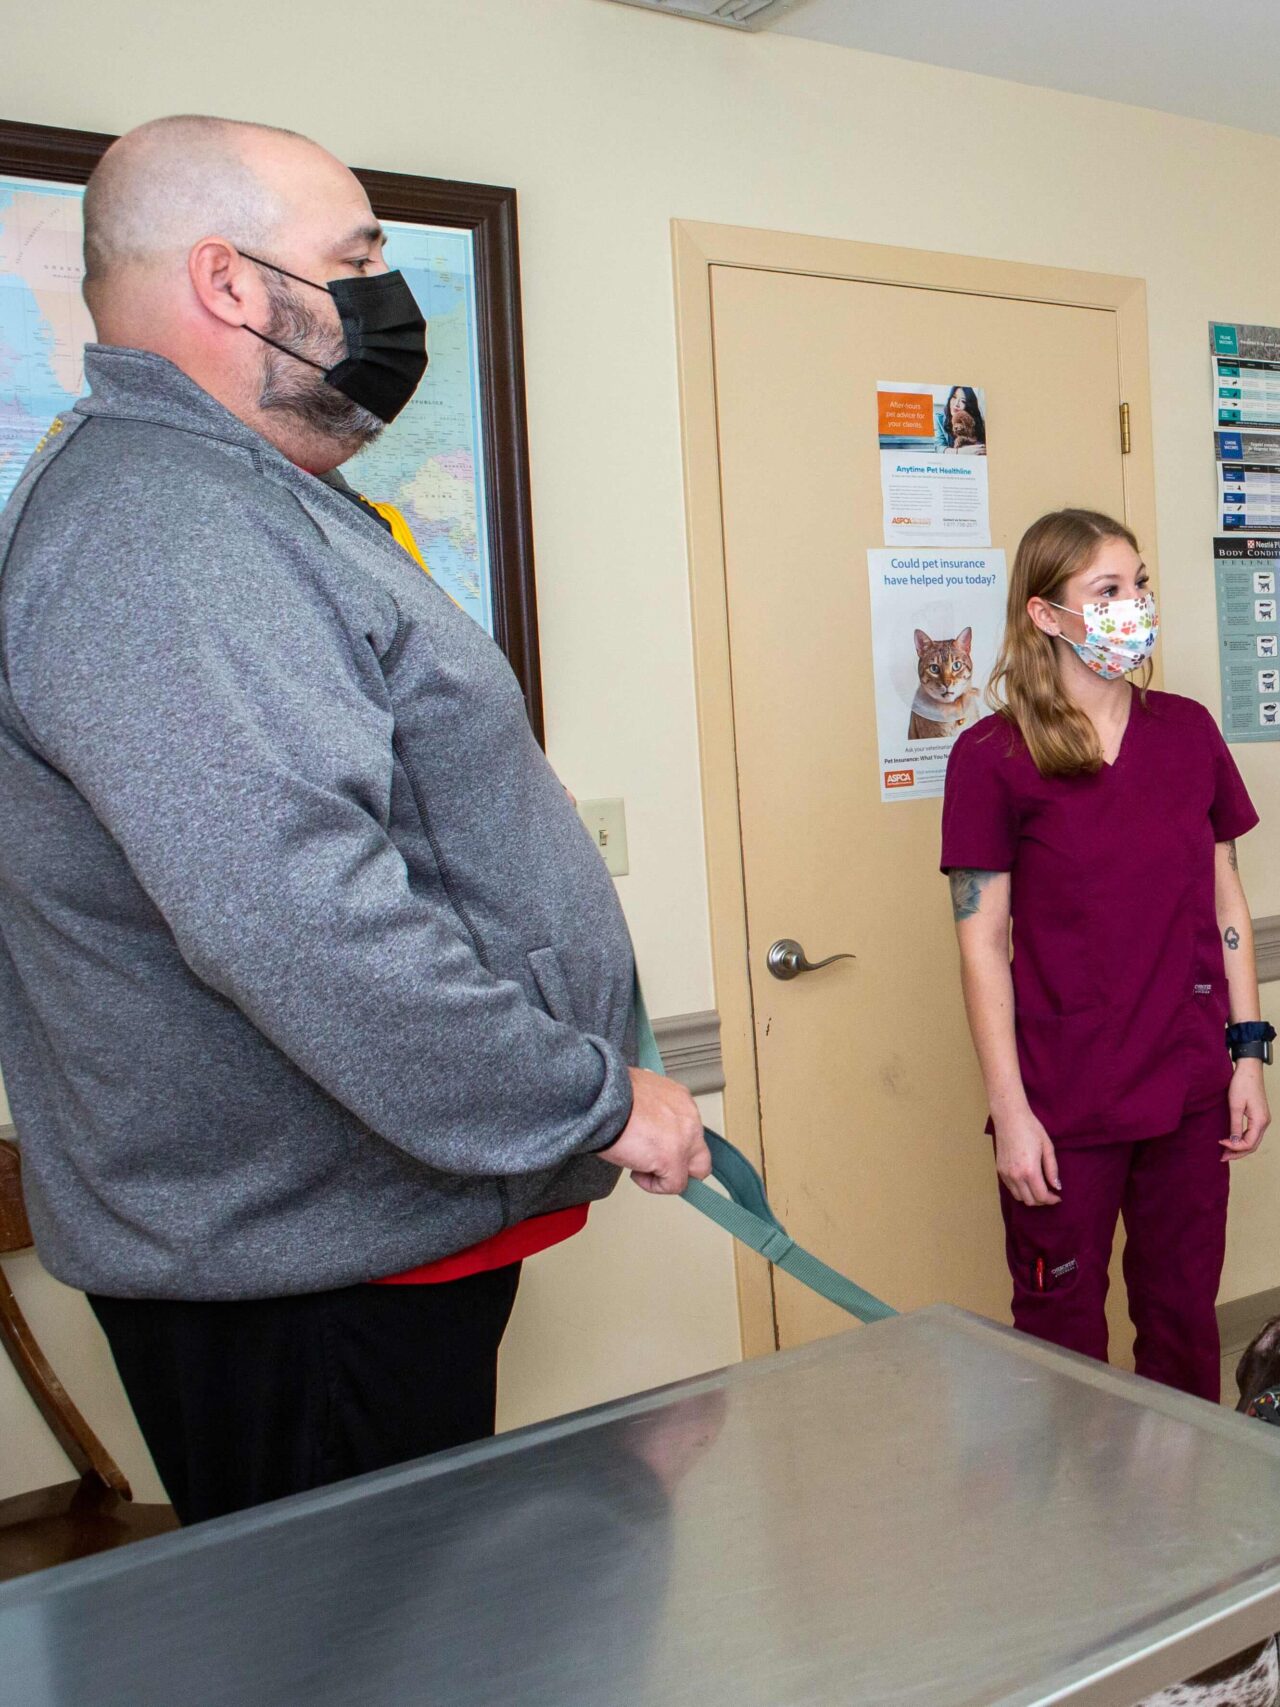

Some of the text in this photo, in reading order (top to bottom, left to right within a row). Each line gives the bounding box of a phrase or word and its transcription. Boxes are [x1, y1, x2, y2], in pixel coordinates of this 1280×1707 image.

[896, 465, 972, 475] Anytime Pet Healthline
[891, 558, 986, 571] Could pet insurance
[884, 574, 996, 587] have helped you today?
[888, 773, 911, 783] ASPCA
